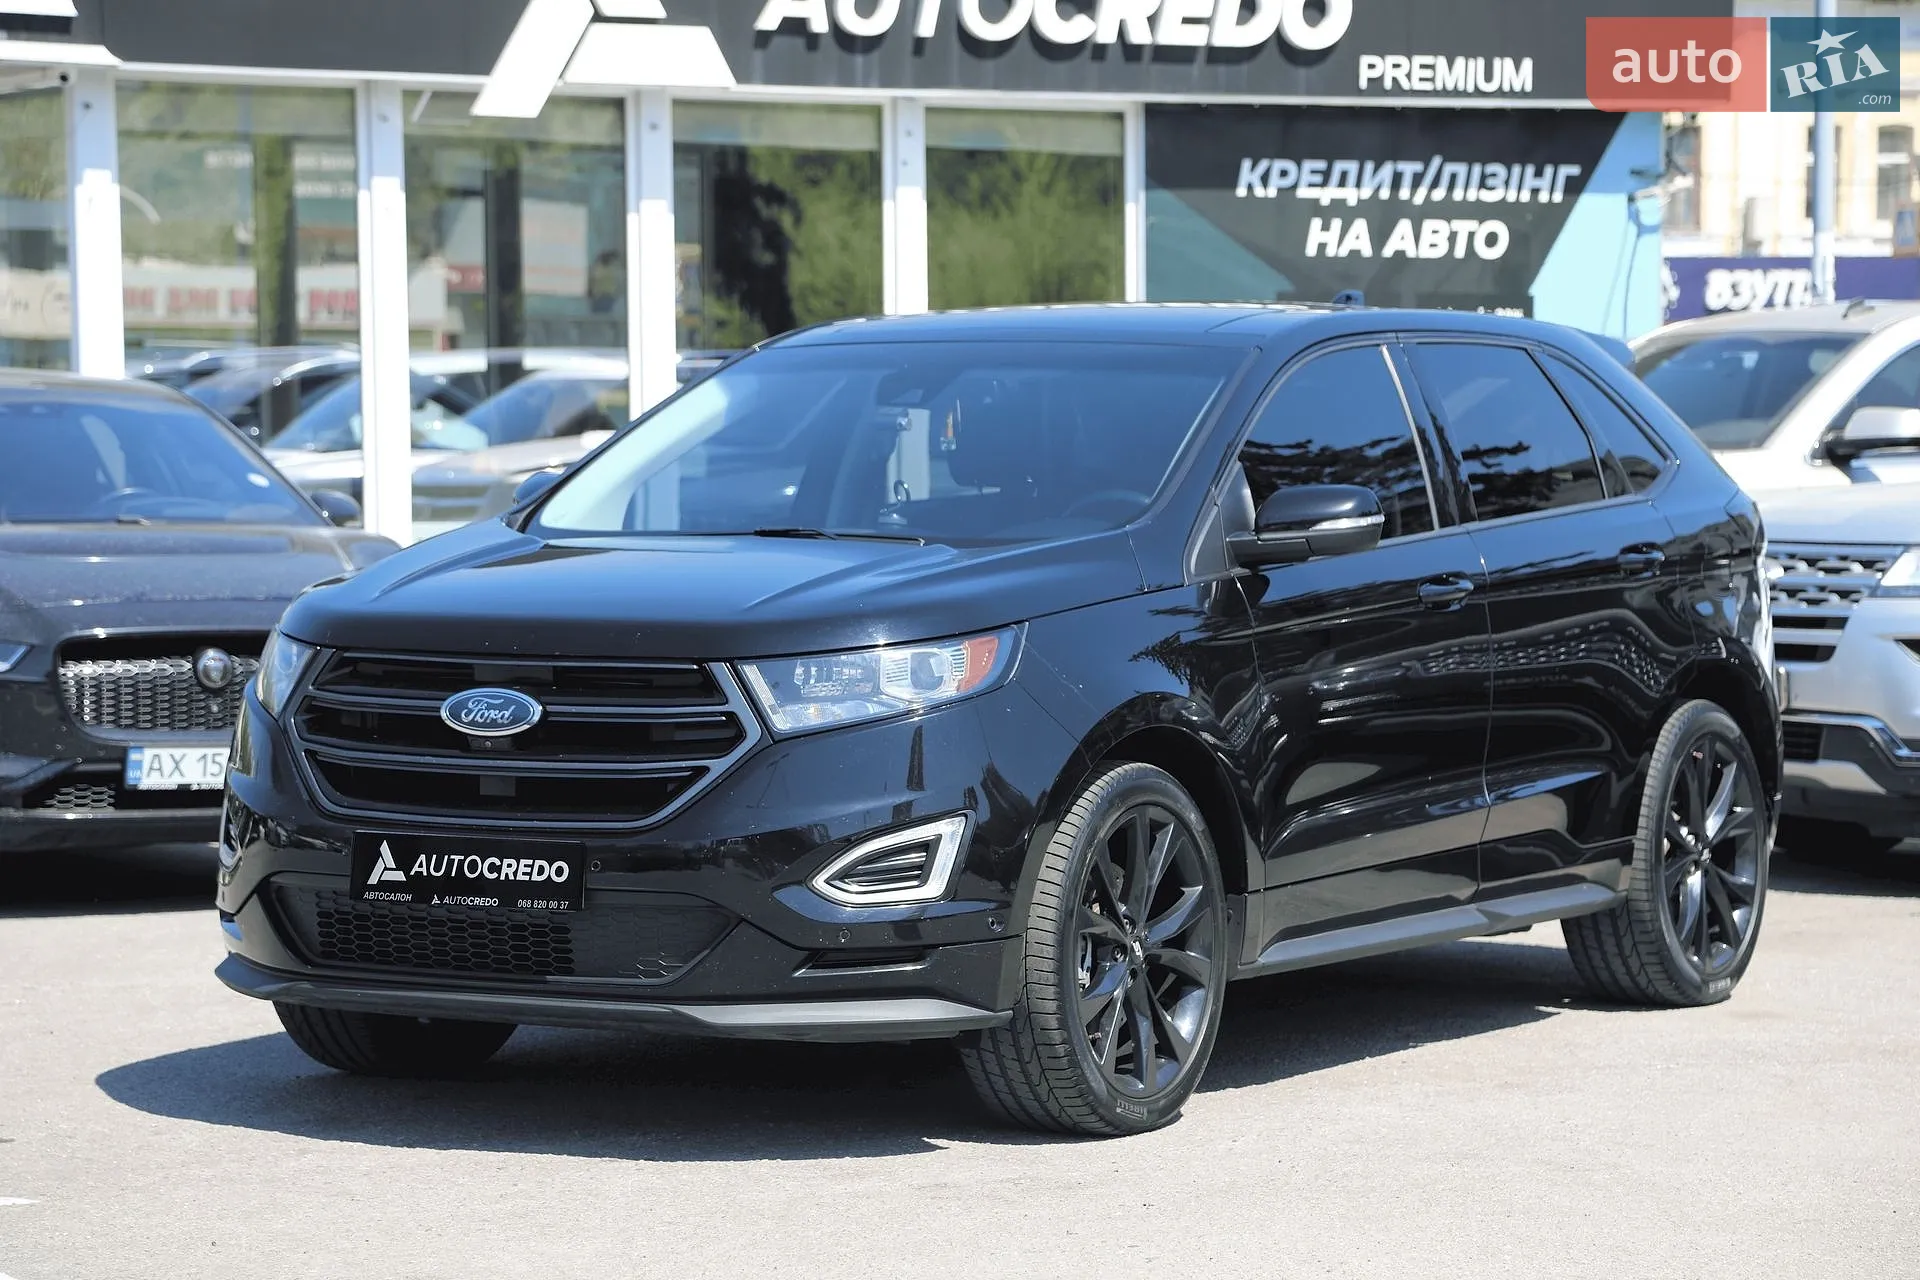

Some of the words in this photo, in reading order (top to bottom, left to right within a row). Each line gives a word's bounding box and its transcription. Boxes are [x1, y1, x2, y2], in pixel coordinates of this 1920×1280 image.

[1358, 53, 1533, 94] PREMIUM
[1235, 155, 1582, 206] КРЕДИТ/ЛІЗІНГ
[1304, 217, 1374, 258] НА
[1380, 217, 1510, 260] АВТО
[461, 697, 516, 724] Ford
[146, 753, 187, 778] AX
[409, 853, 570, 883] AUTOCREDO
[362, 891, 413, 902] АВТОСАЛОН
[442, 895, 499, 907] AUTOCREDO
[517, 899, 532, 908] 068
[533, 900, 547, 909] 820
[548, 900, 558, 909] 00
[559, 901, 569, 910] 37
